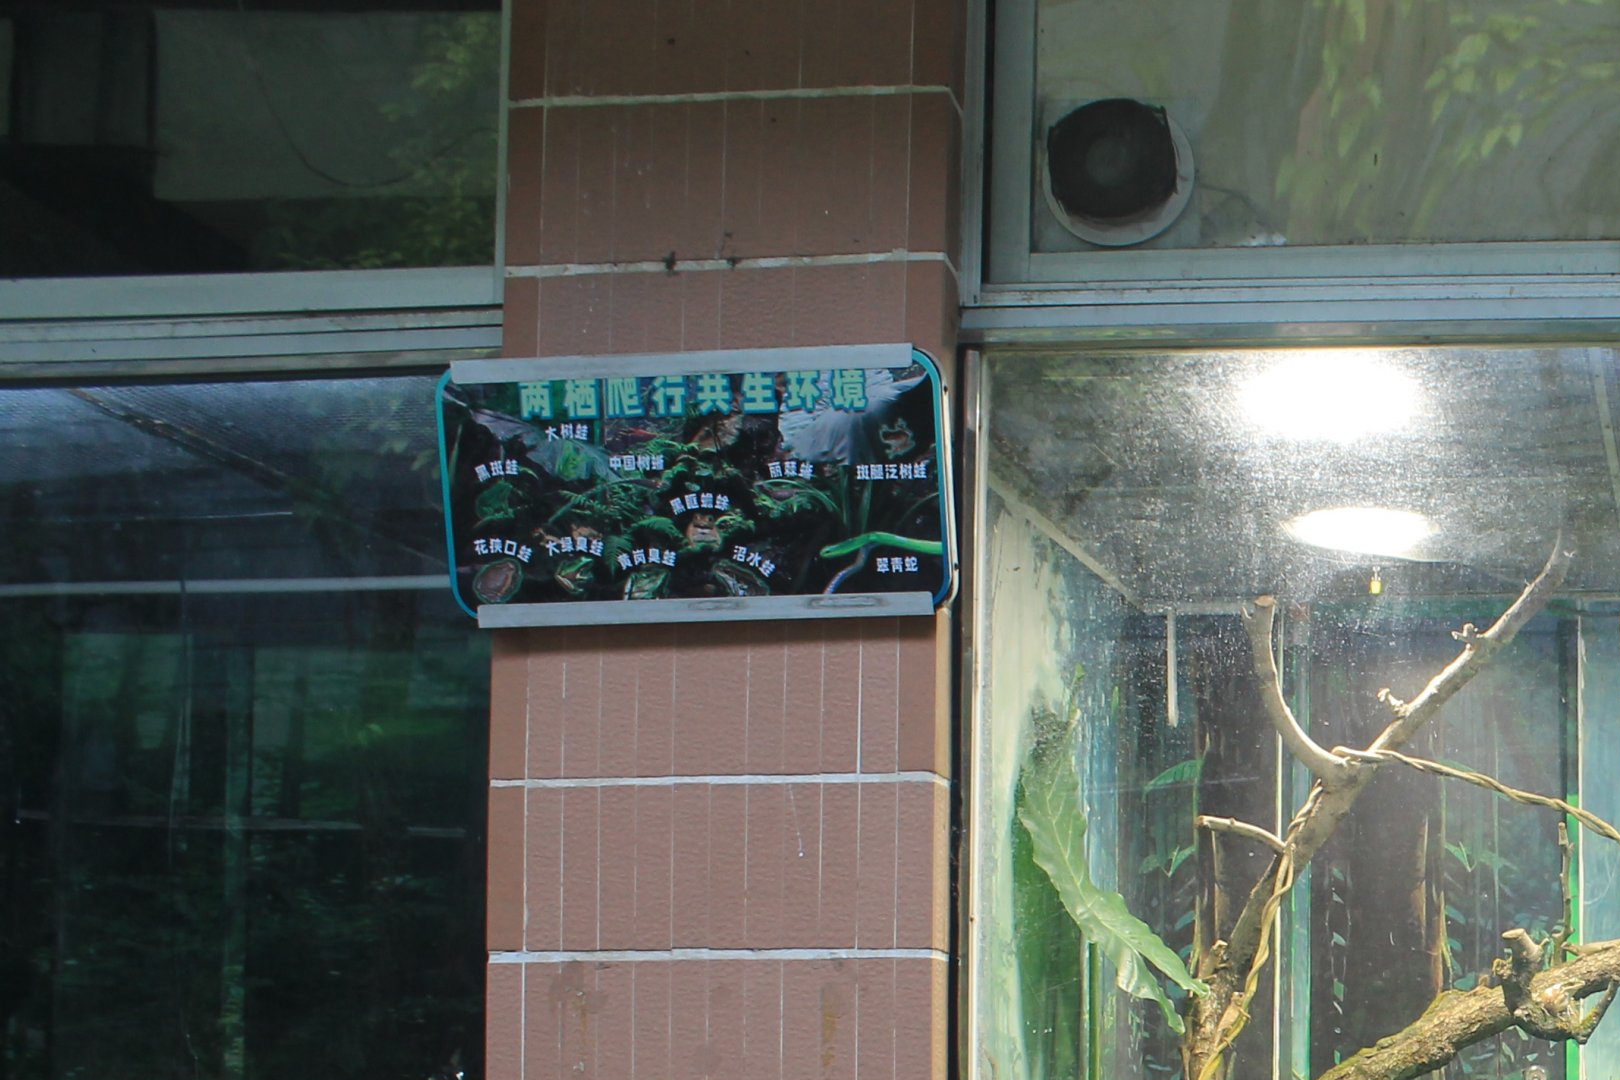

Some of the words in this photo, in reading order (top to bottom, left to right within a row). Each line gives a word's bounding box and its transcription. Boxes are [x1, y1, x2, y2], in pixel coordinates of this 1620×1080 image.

[518, 368, 869, 420] 两栖爬行共生环境
[545, 423, 589, 442] 大树蛙
[474, 459, 519, 482] 黑斑蛙
[856, 462, 927, 480] 斑腿泛树蛙
[474, 538, 533, 563] 花狭口蛙
[546, 537, 604, 557] 大绿臭蛙
[733, 545, 776, 578] 沼水蛙
[876, 556, 918, 573] 翠青蛇
